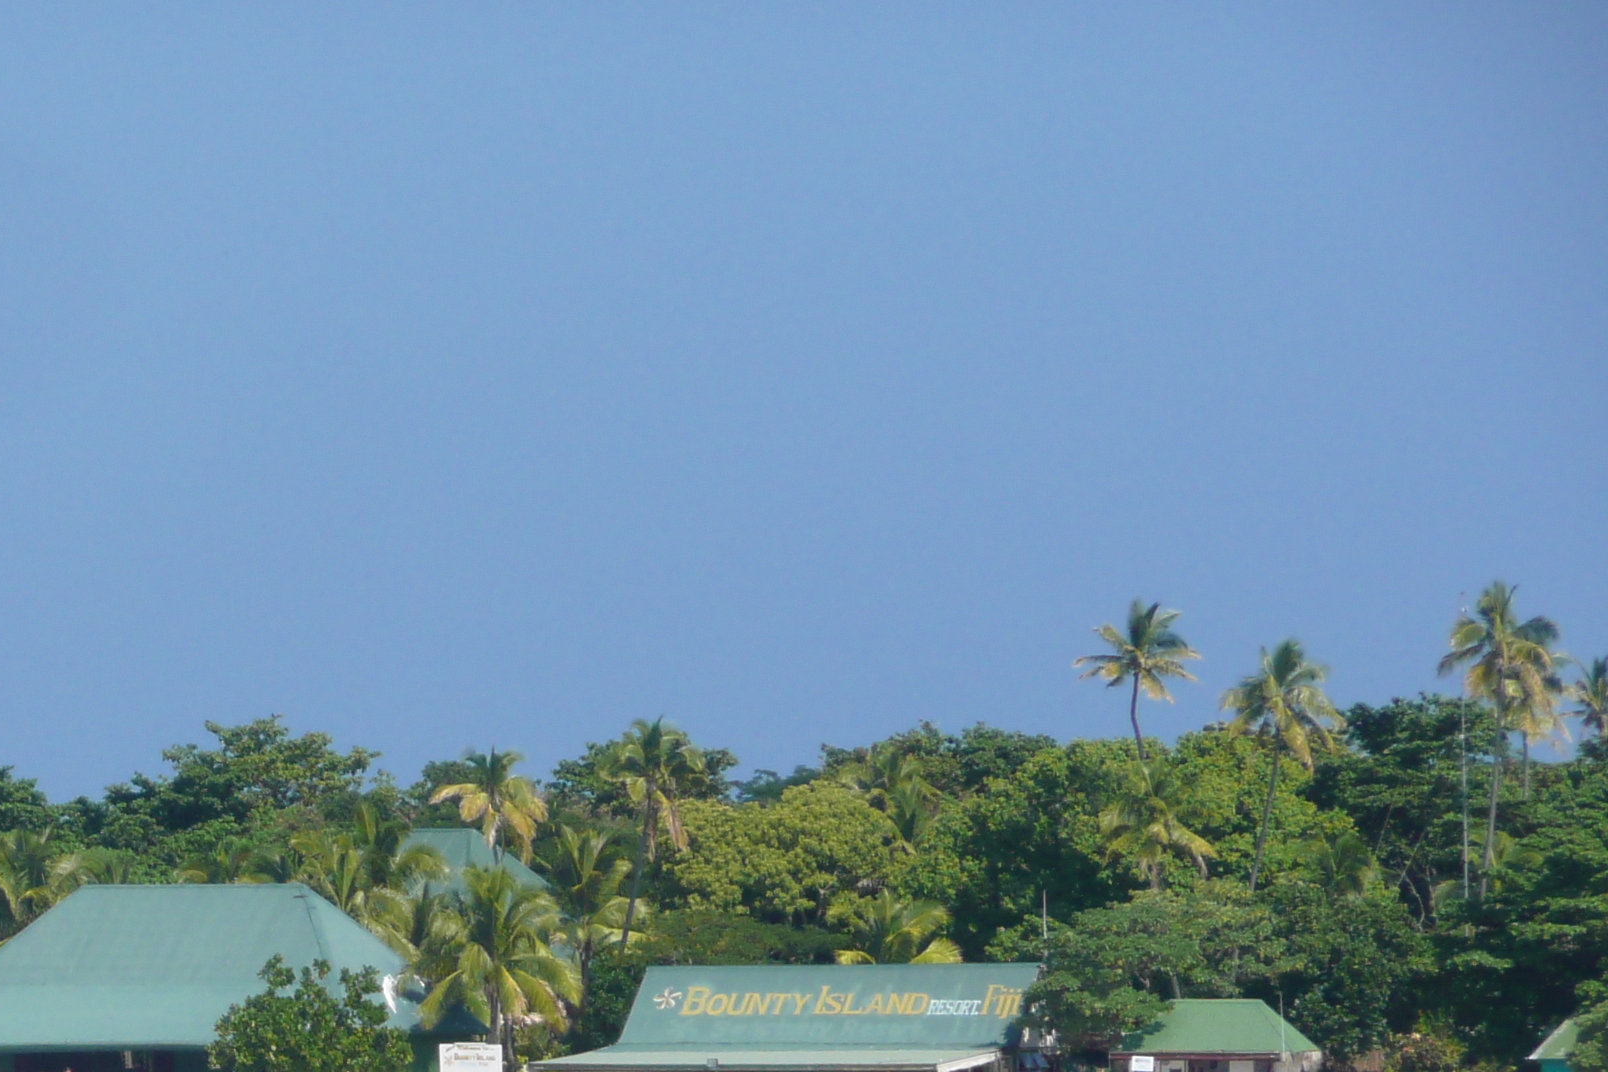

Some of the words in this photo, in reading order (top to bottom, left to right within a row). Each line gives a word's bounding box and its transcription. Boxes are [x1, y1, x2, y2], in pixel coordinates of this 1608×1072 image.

[680, 986, 812, 1015] BOUNTY
[814, 985, 929, 1015] ISLAND
[980, 984, 1022, 1019] Fiji
